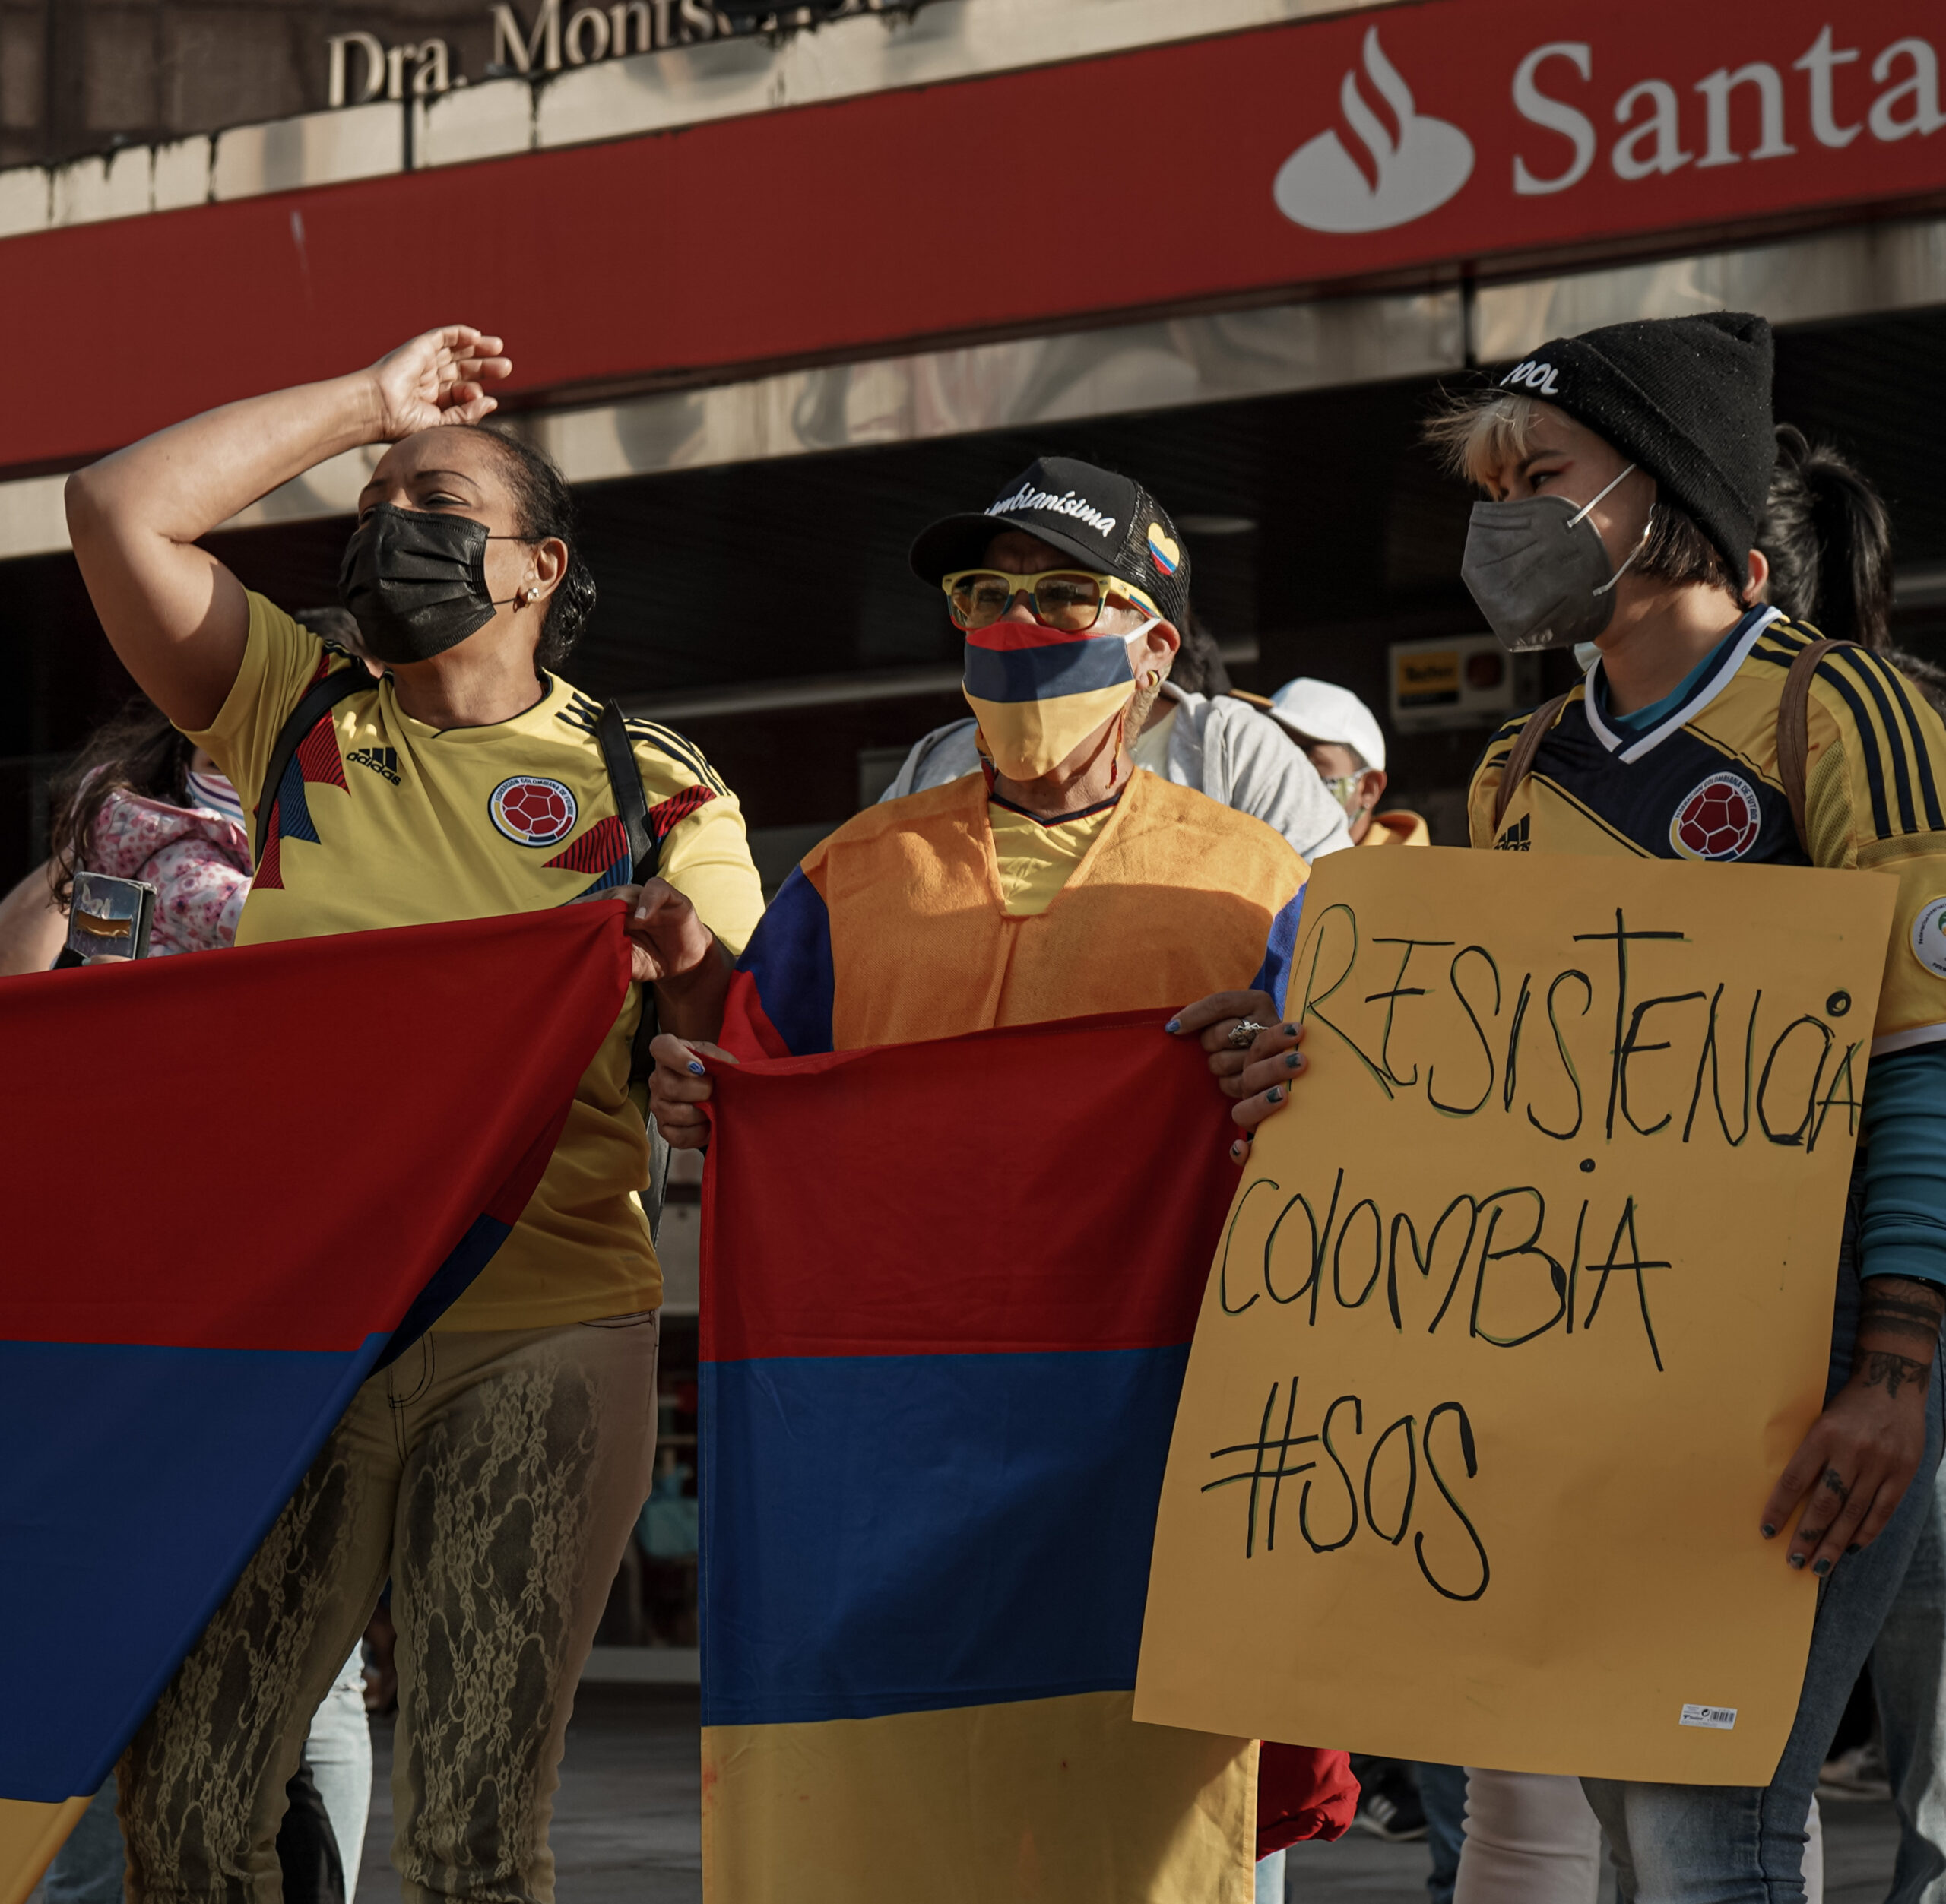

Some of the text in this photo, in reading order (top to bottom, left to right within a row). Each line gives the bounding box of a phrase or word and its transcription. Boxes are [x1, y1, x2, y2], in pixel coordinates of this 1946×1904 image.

[328, 31, 468, 108] Dra.
[1511, 24, 1946, 196] Santa
[346, 752, 402, 786] adidas
[1200, 1375, 1491, 1602] #SOS
